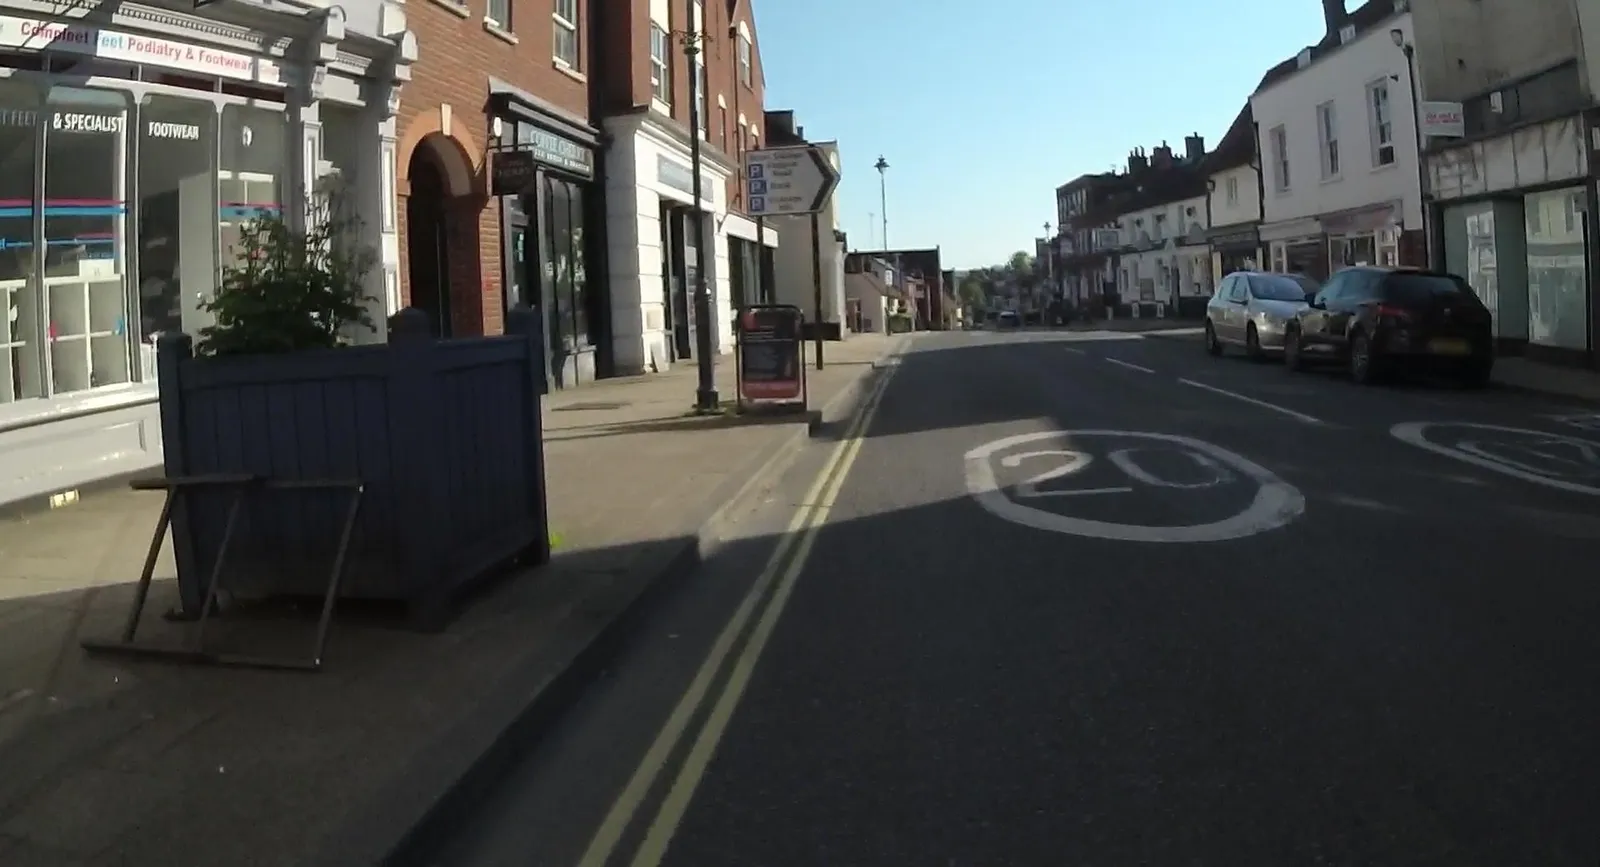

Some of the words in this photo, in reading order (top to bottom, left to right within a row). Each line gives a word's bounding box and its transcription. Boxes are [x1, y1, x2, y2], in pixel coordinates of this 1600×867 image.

[127, 36, 182, 61] Podiatry
[185, 47, 194, 61] &
[198, 49, 253, 71] Footwear
[11, 108, 37, 127] FEET
[53, 112, 62, 130] &
[63, 112, 123, 133] SPECIALIST
[148, 121, 200, 141] FOOTWEAR
[1001, 448, 1237, 498] 20
